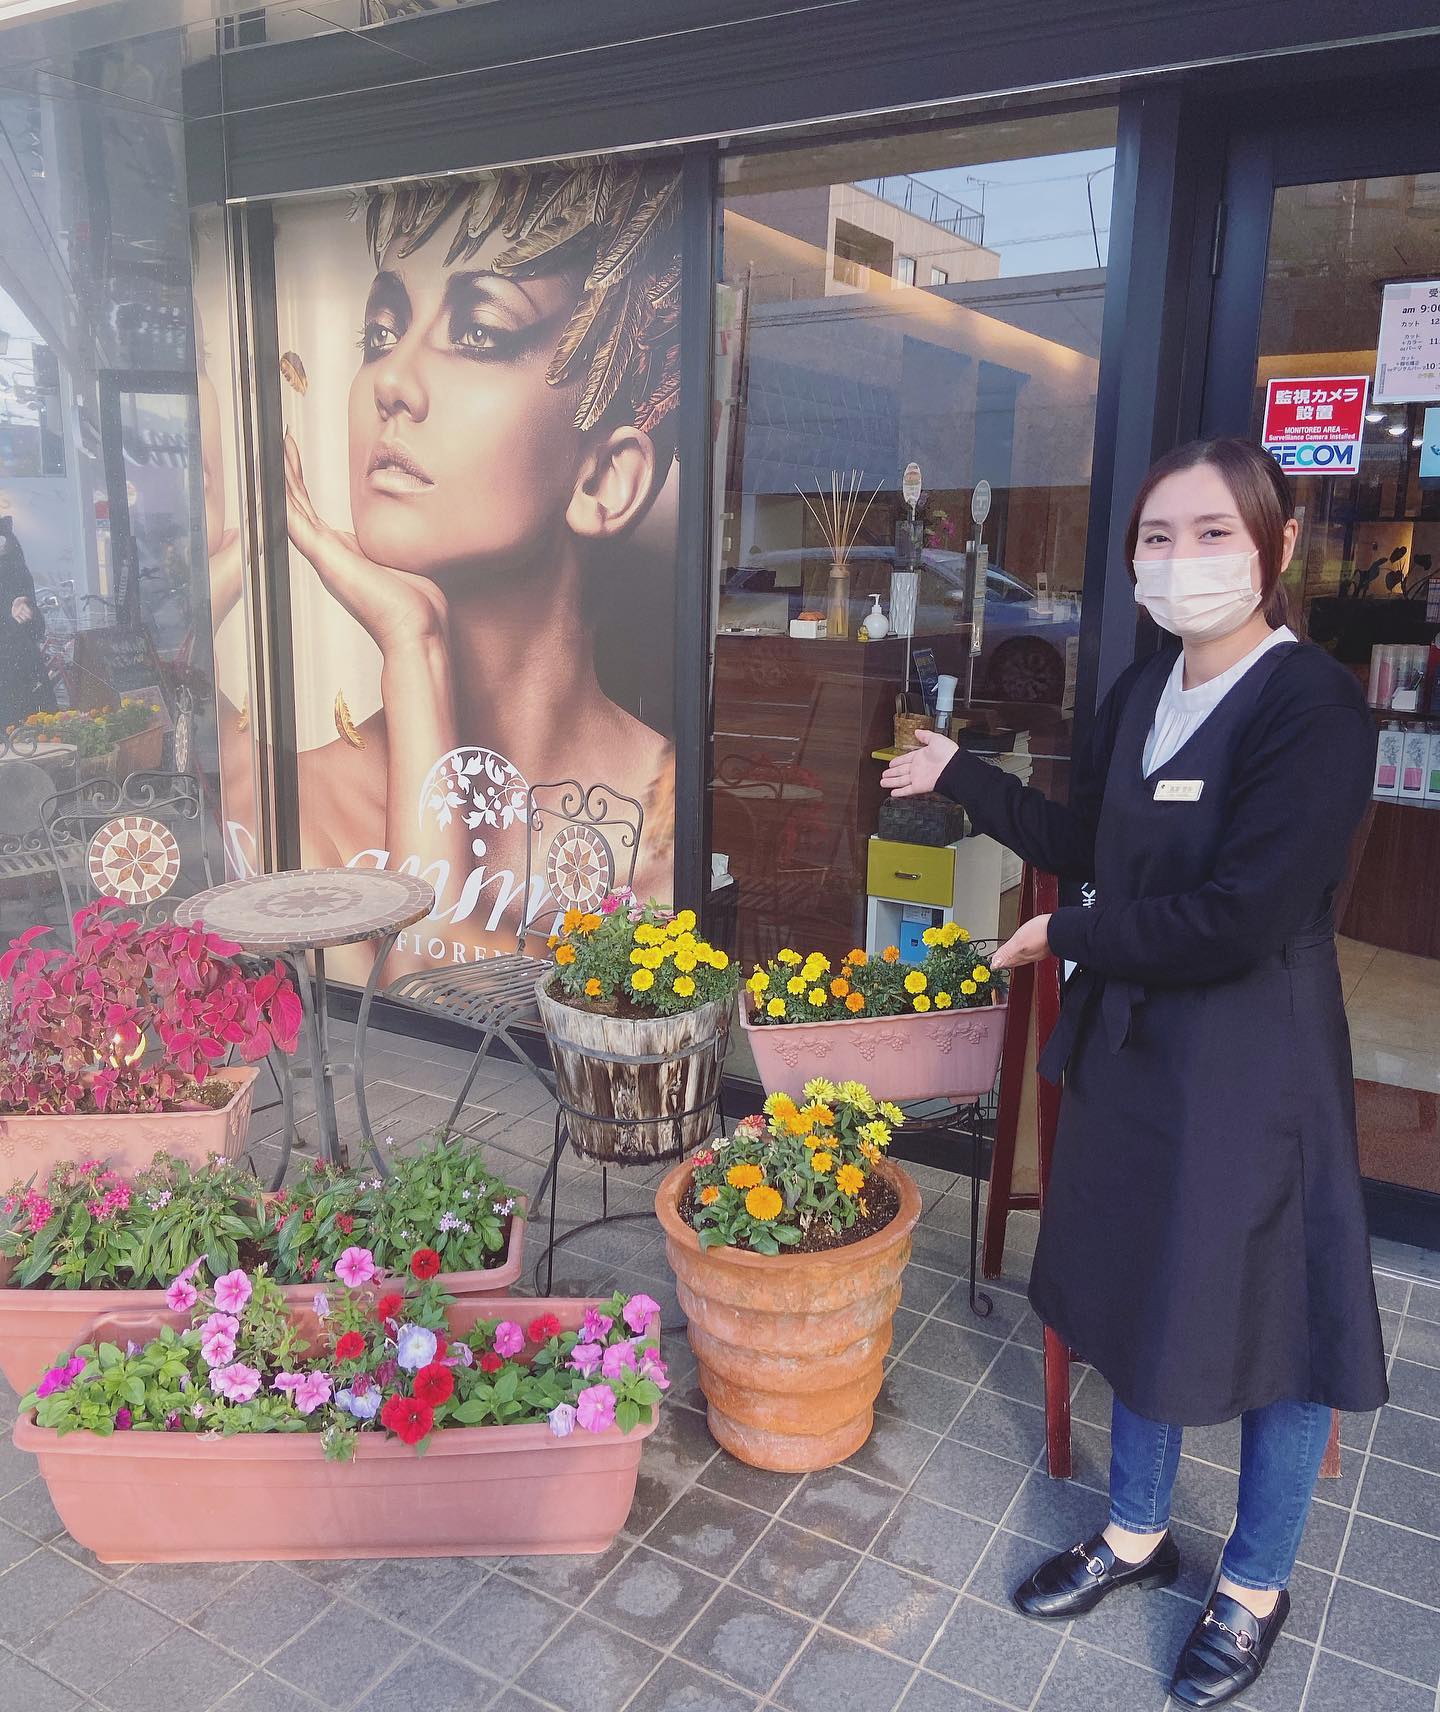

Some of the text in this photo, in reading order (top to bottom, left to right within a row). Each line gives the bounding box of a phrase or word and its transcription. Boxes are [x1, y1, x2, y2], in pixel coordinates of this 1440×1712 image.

[1275, 388, 1358, 405] 監視カメラ
[1296, 405, 1333, 420] 設置
[1284, 425, 1341, 434] MONITORED AREA
[1305, 433, 1329, 441] Camera
[1329, 432, 1356, 440] Installed
[1268, 444, 1354, 466] SECOM
